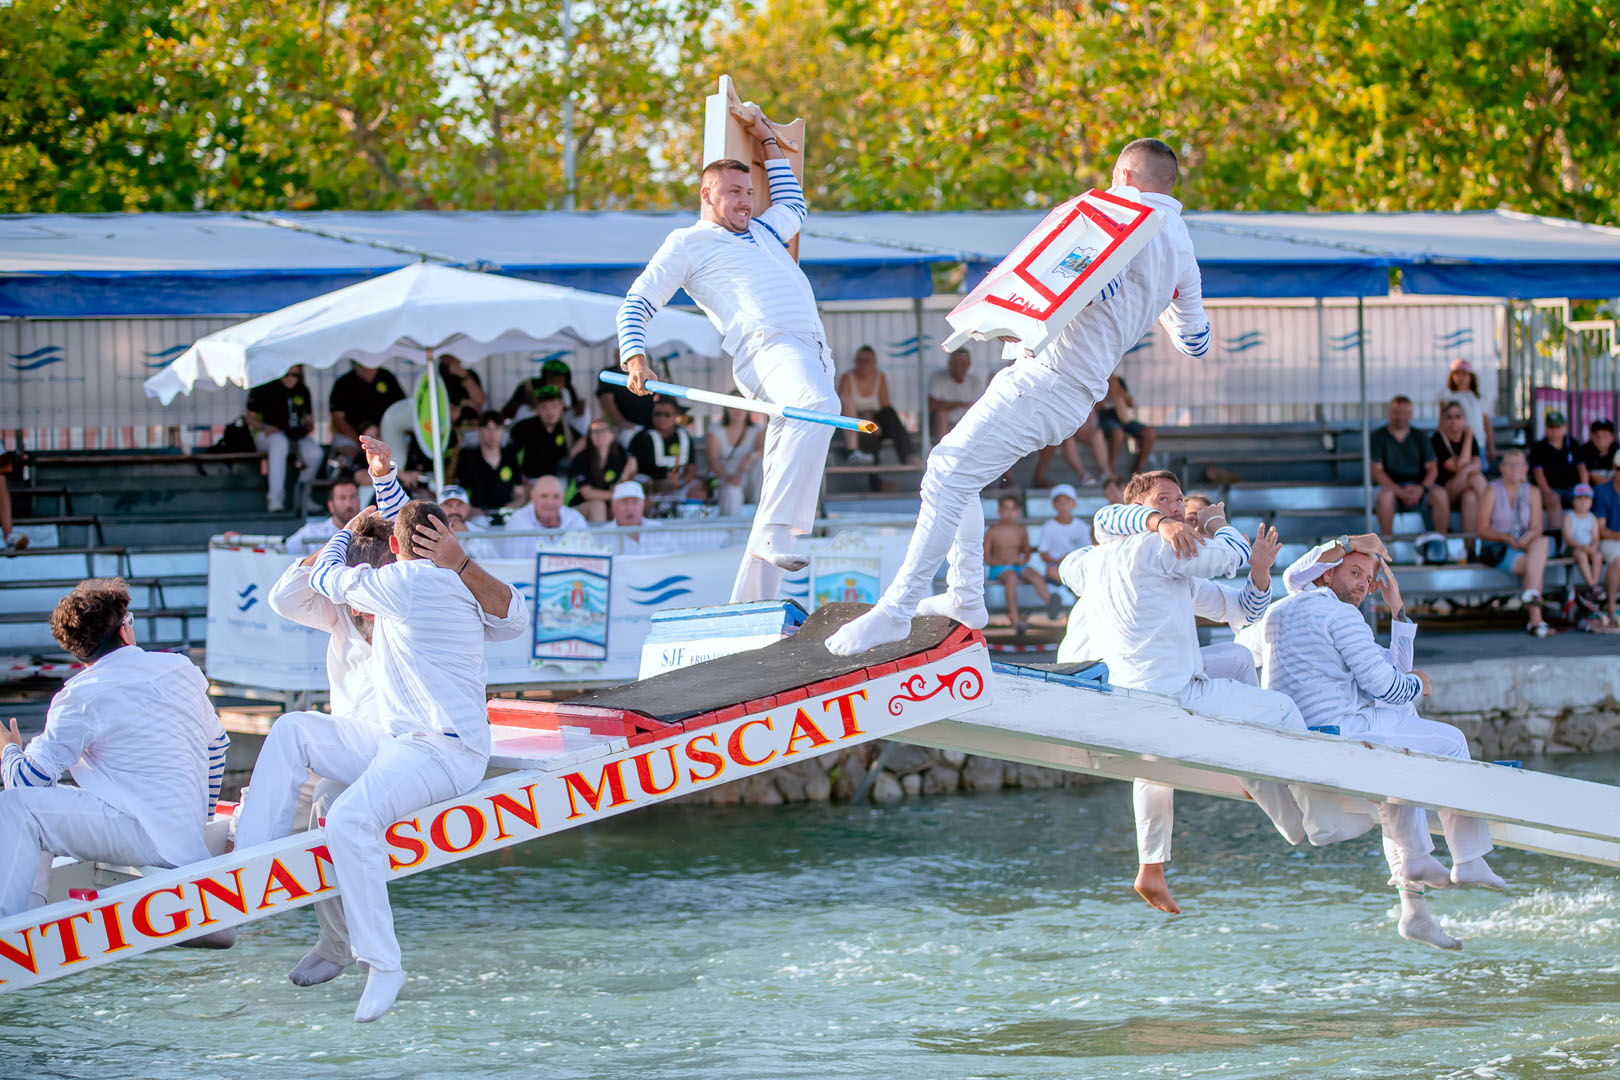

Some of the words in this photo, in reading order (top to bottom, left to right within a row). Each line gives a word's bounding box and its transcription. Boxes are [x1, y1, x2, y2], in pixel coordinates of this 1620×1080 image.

[661, 647, 686, 668] SJF
[385, 784, 541, 873] SON
[558, 688, 869, 821] MUSCAT
